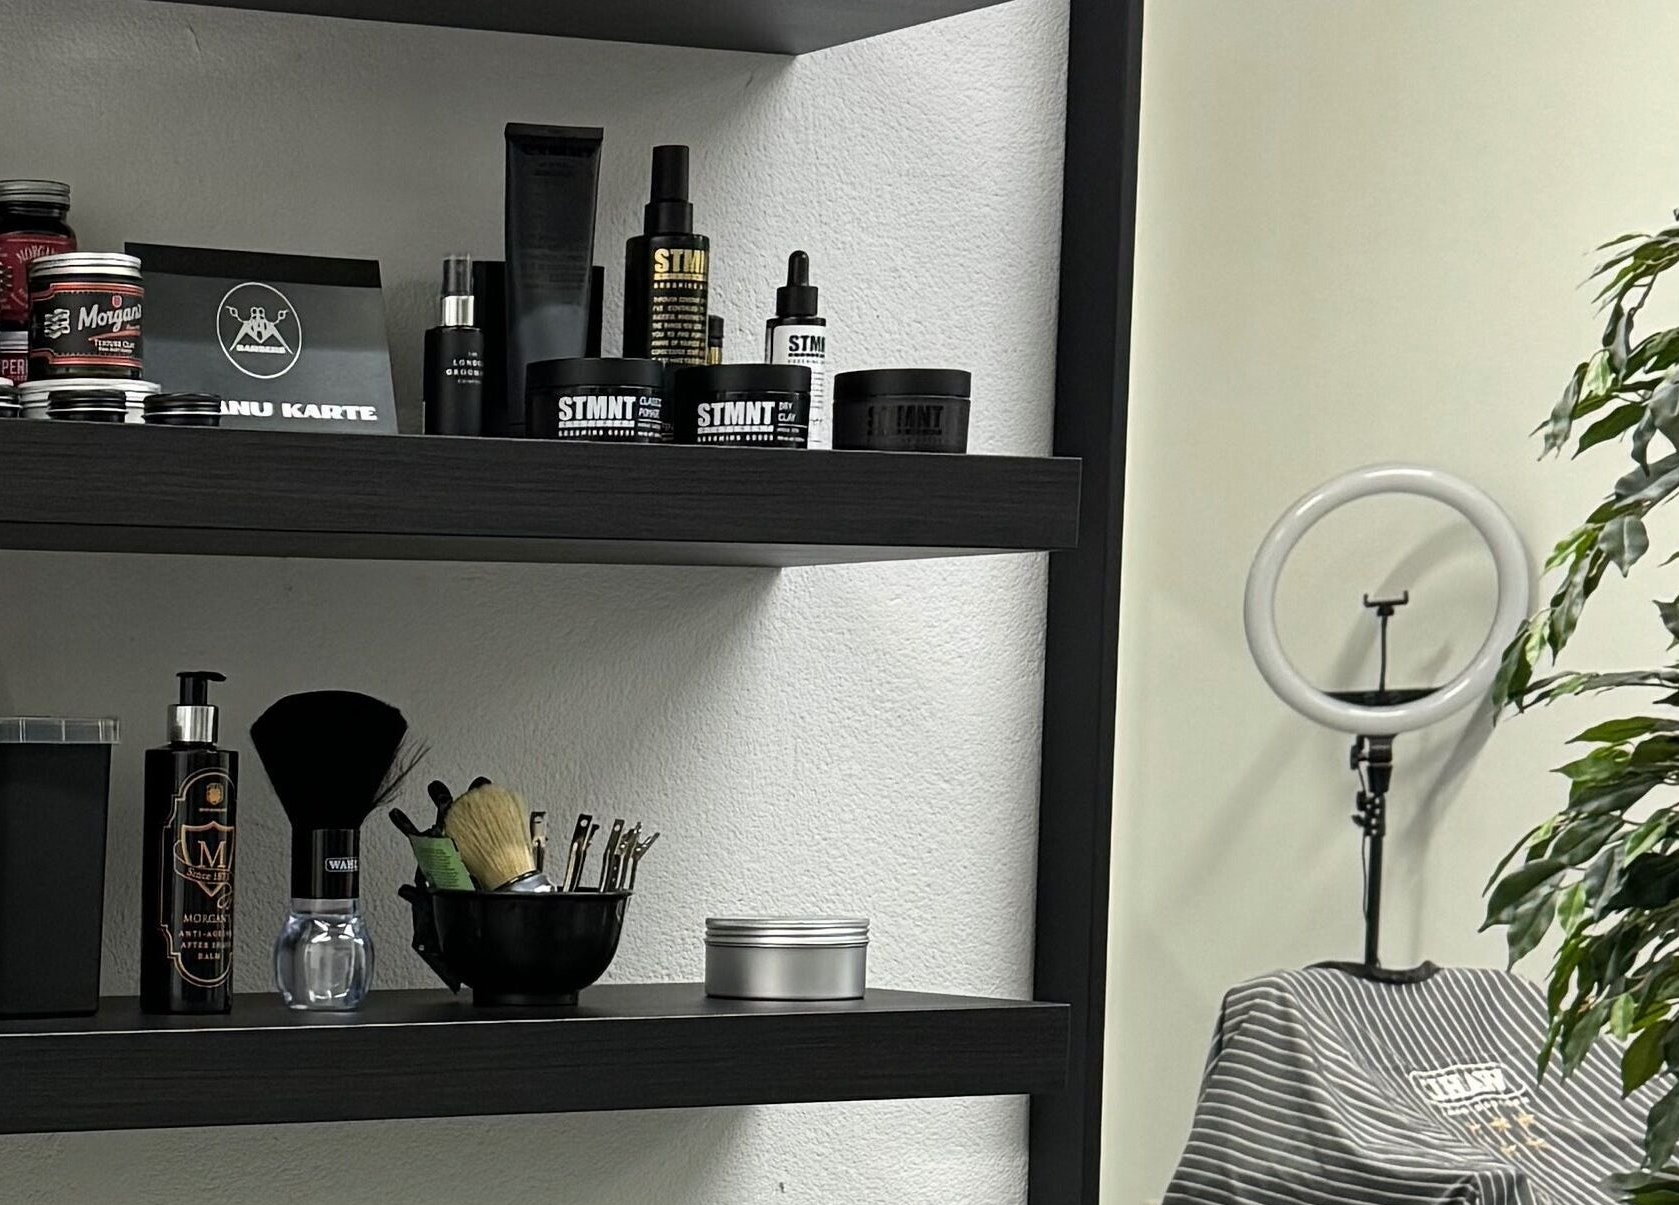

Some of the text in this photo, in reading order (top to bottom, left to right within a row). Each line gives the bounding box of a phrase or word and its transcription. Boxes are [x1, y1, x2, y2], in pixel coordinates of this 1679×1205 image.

[281, 402, 378, 421] KARTE
[558, 395, 637, 421] STMNT
[697, 401, 776, 427] STMNT
[197, 840, 227, 869] M
